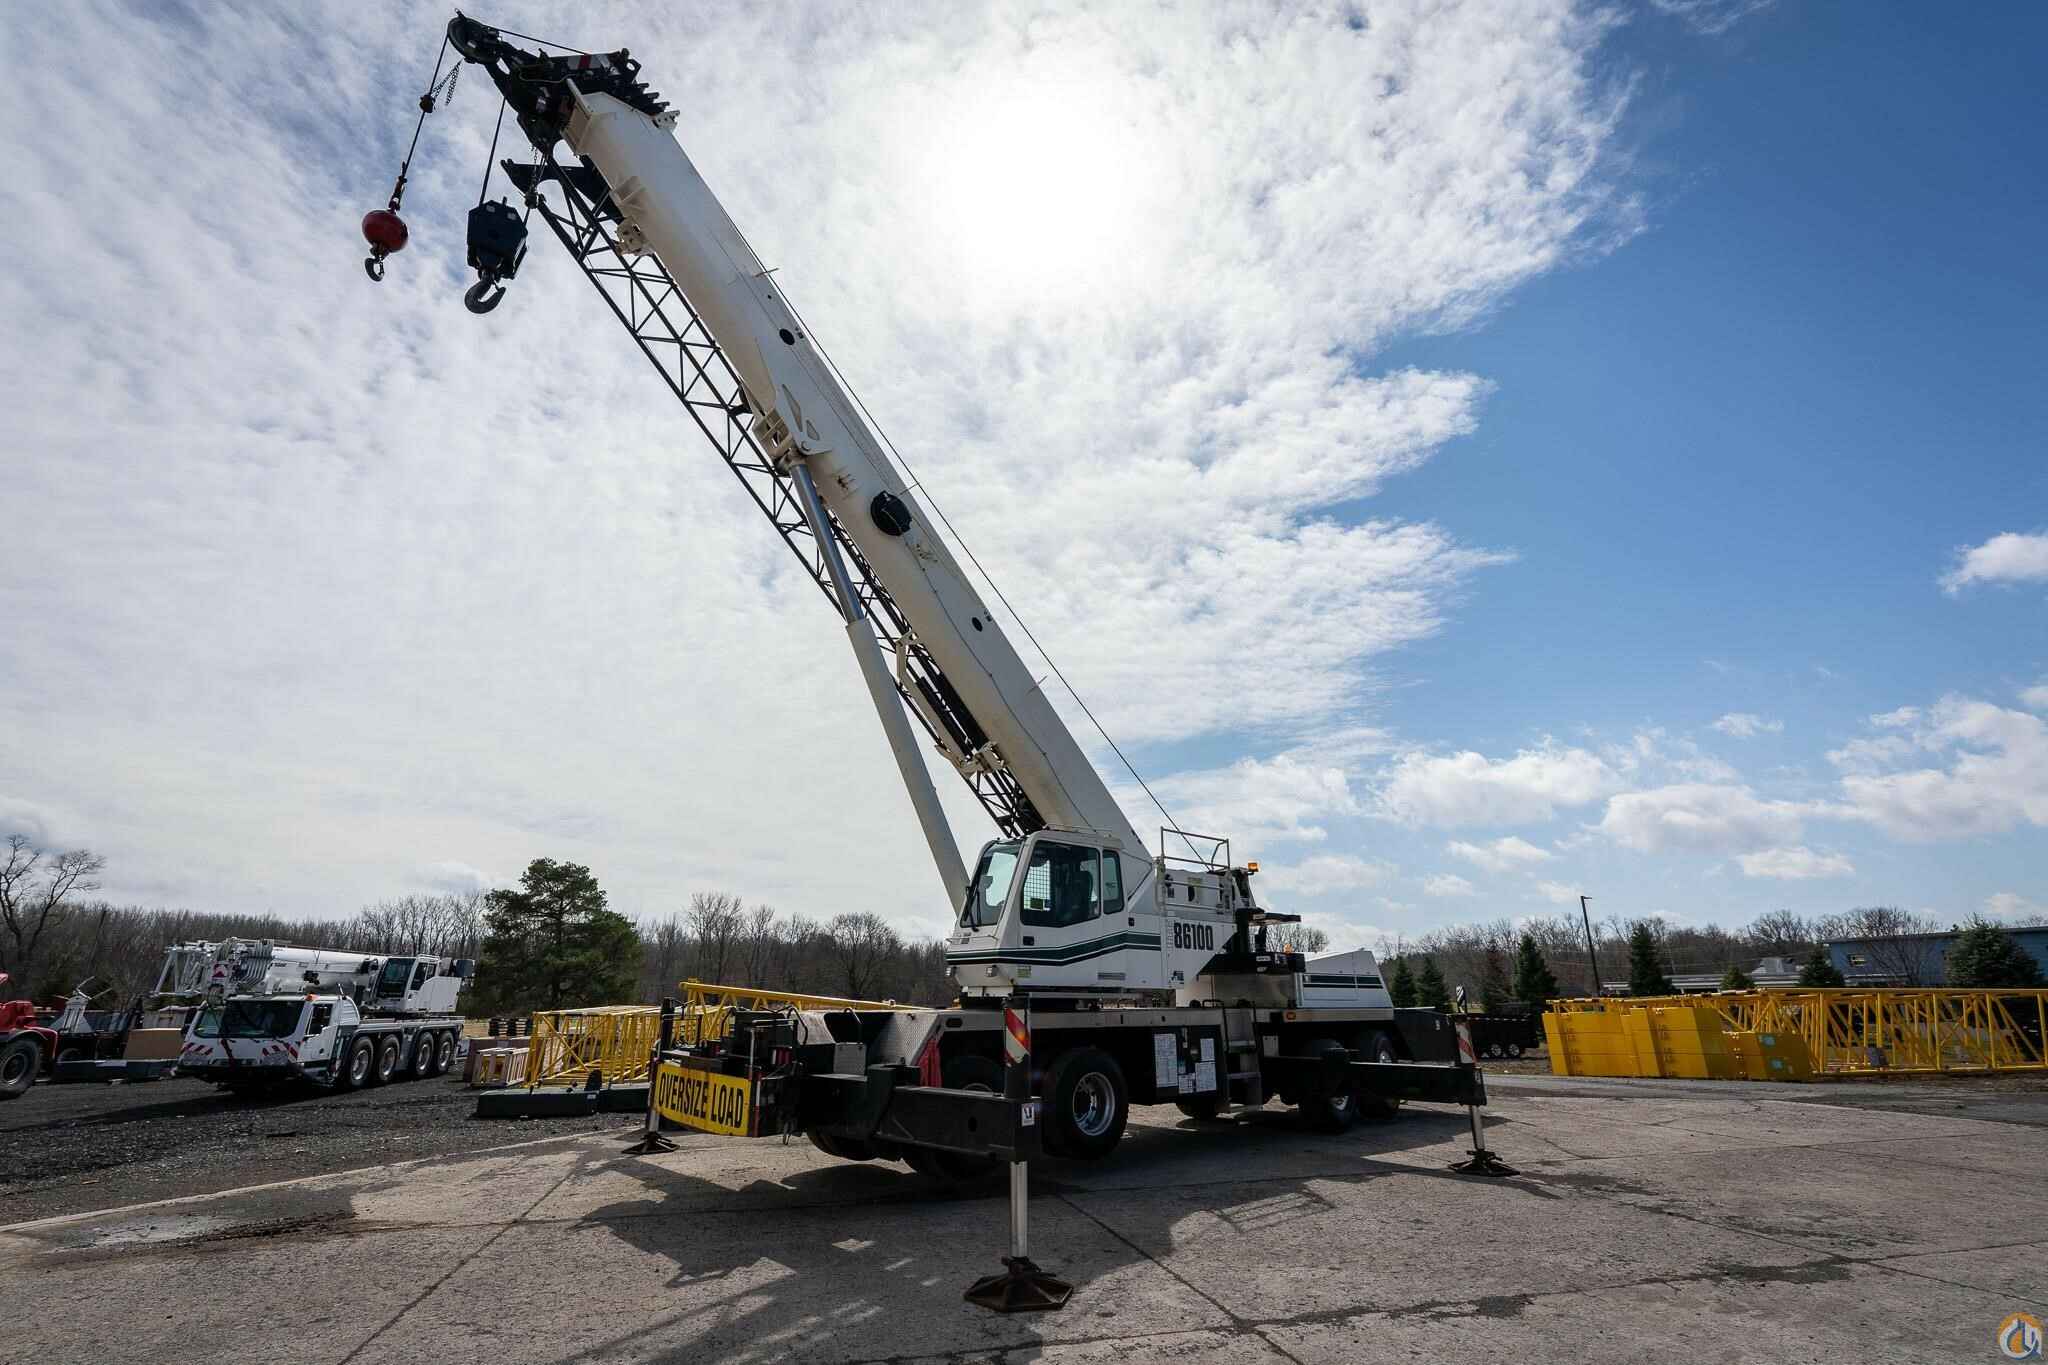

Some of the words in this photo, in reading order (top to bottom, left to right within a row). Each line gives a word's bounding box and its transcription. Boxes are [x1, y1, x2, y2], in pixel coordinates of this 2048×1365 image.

[1173, 922, 1214, 951] 86100
[658, 1072, 709, 1119] OVERSIZE
[710, 1083, 744, 1128] LOAD
